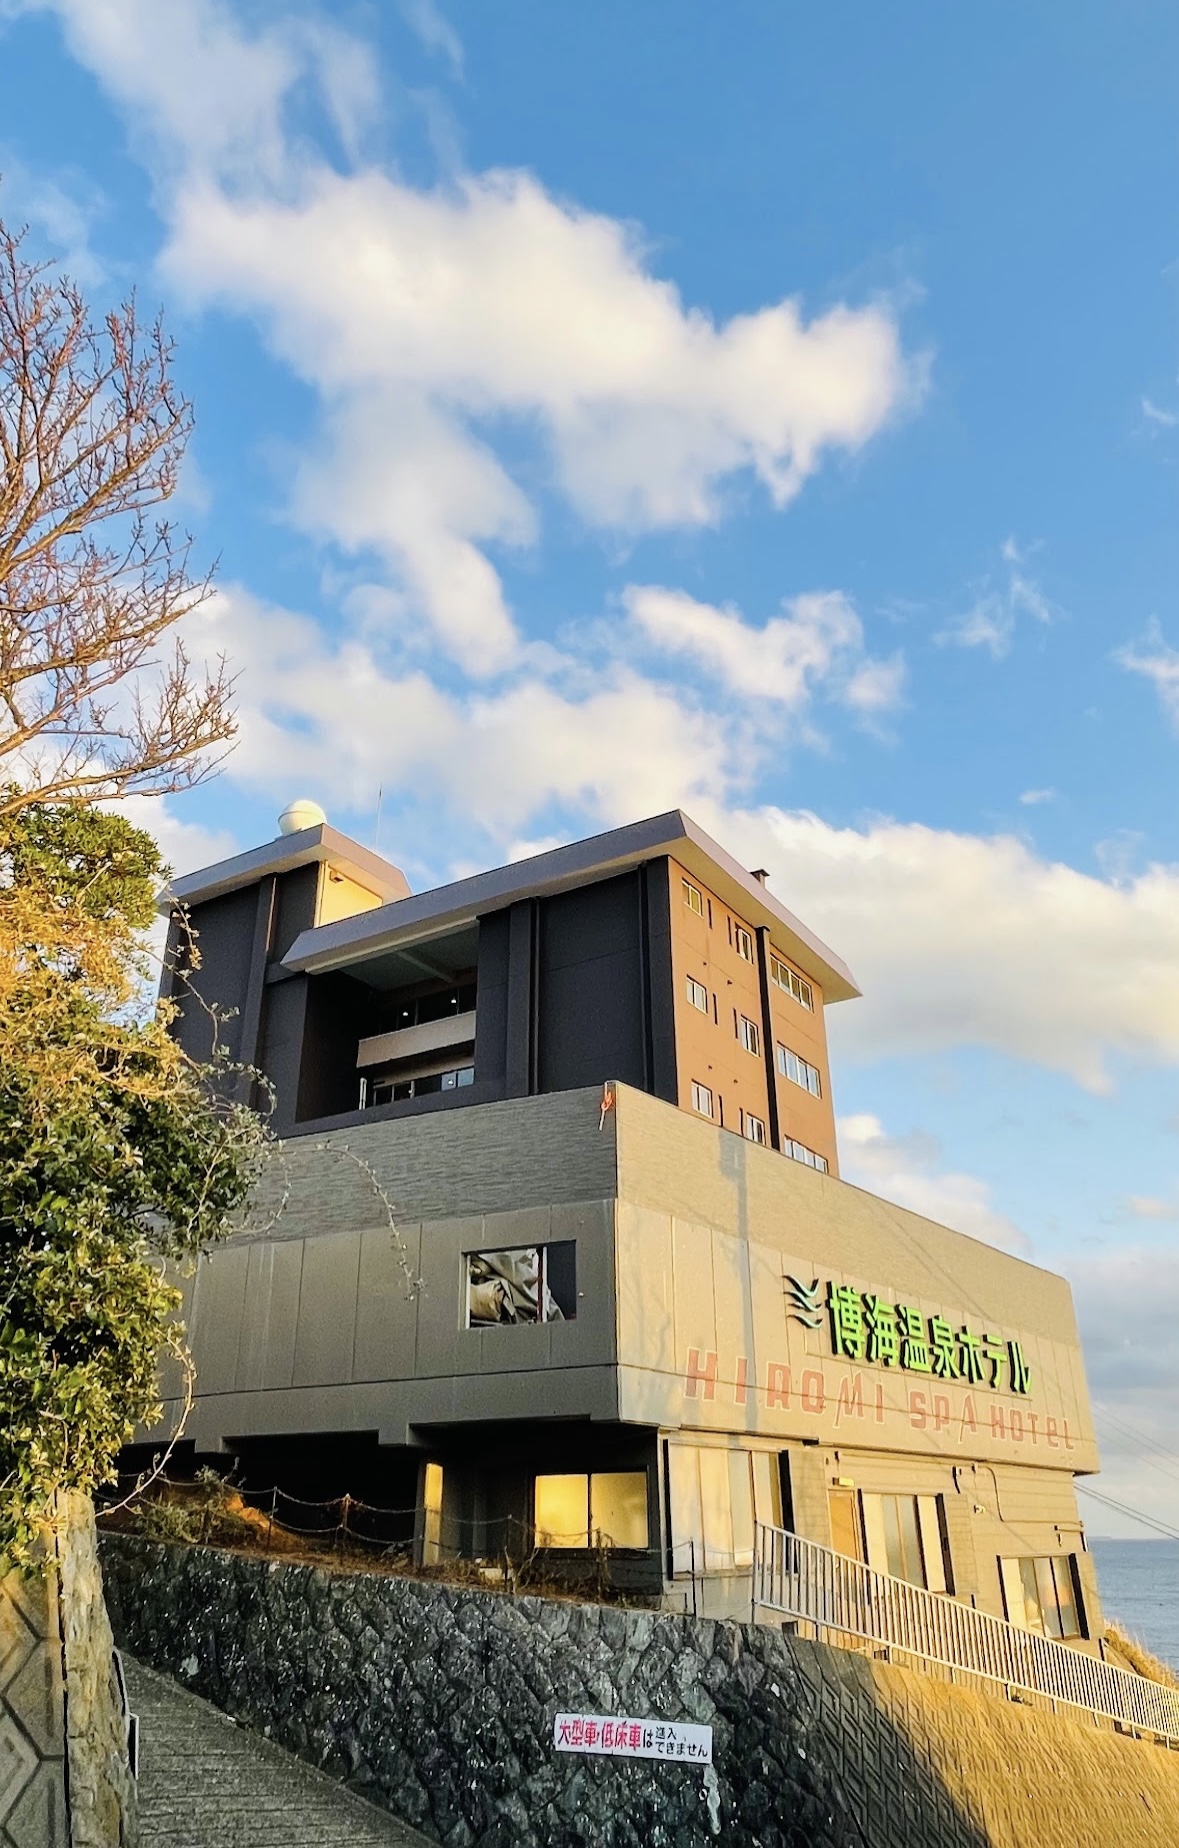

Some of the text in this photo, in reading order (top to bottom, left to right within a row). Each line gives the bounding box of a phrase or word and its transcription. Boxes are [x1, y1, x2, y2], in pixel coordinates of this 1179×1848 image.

[827, 1281, 1032, 1394] 博海温泉ホテル
[685, 1347, 885, 1428] HIROMI
[909, 1390, 978, 1443] SPA
[655, 1741, 708, 1758] できません
